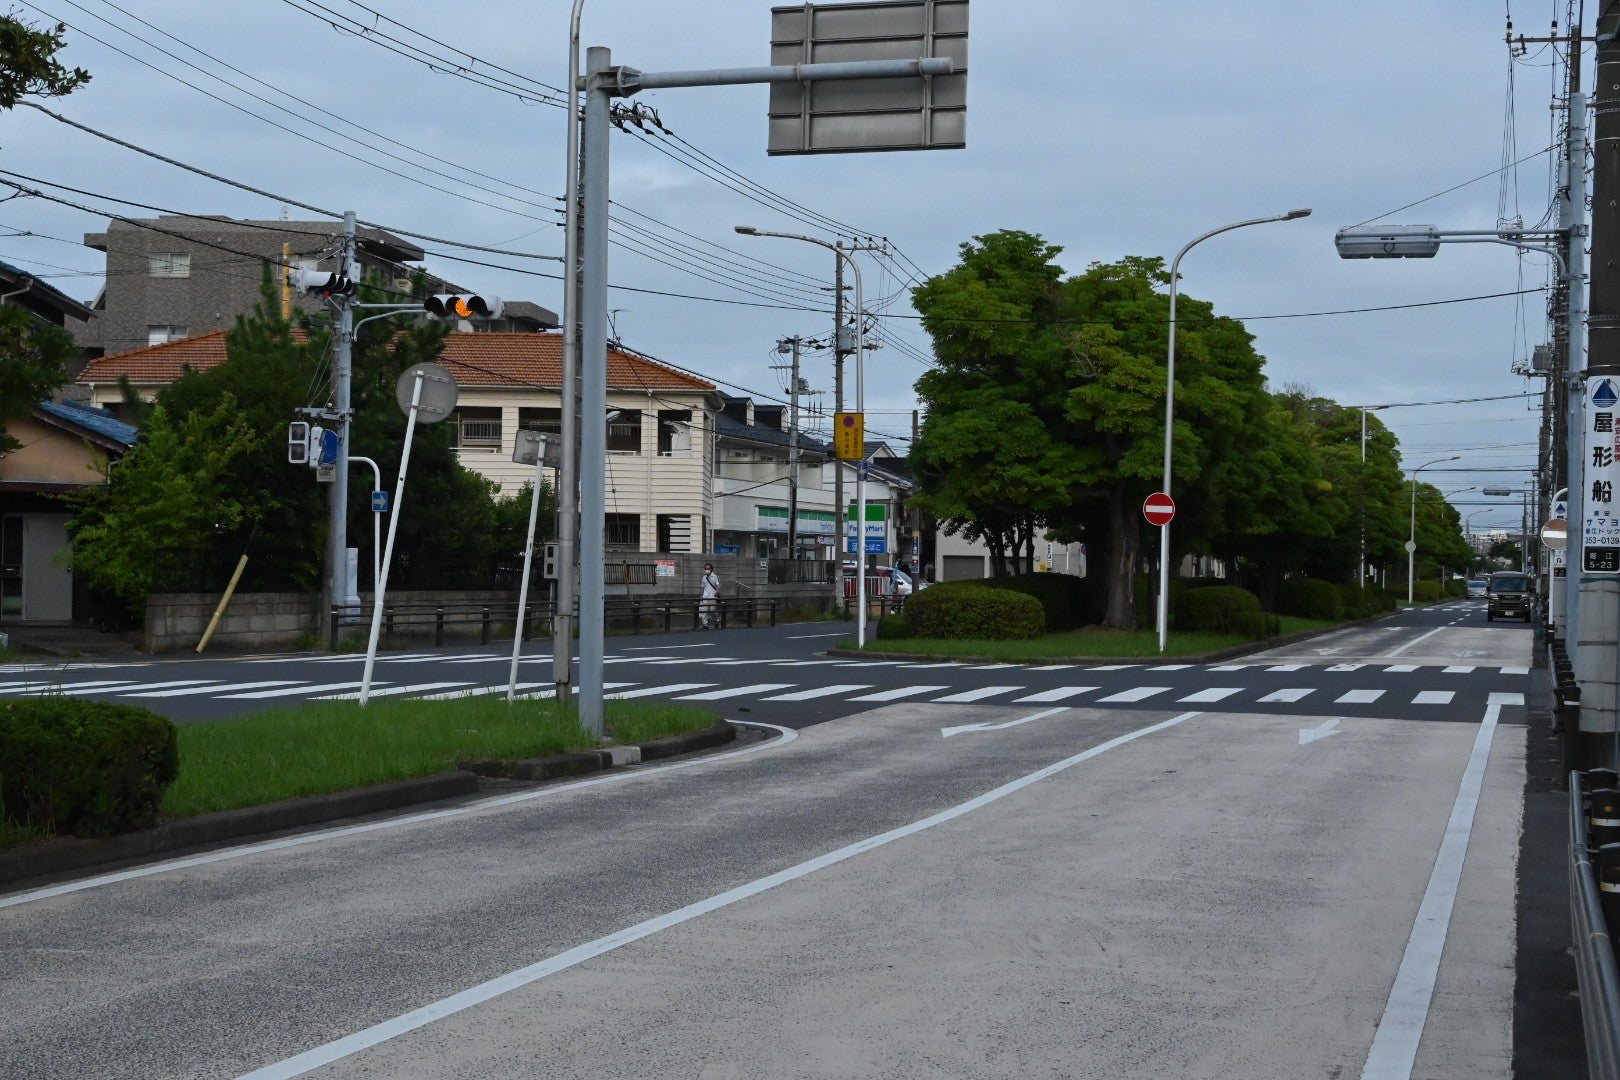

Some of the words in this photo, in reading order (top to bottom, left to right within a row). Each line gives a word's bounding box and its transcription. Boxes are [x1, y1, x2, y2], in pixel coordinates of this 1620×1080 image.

[1592, 412, 1612, 502] 屋形船
[1586, 519, 1619, 527] サマヨ
[849, 525, 883, 533] FayMart
[1585, 536, 1620, 544] 353-0139
[1589, 561, 1613, 569] 5-23
